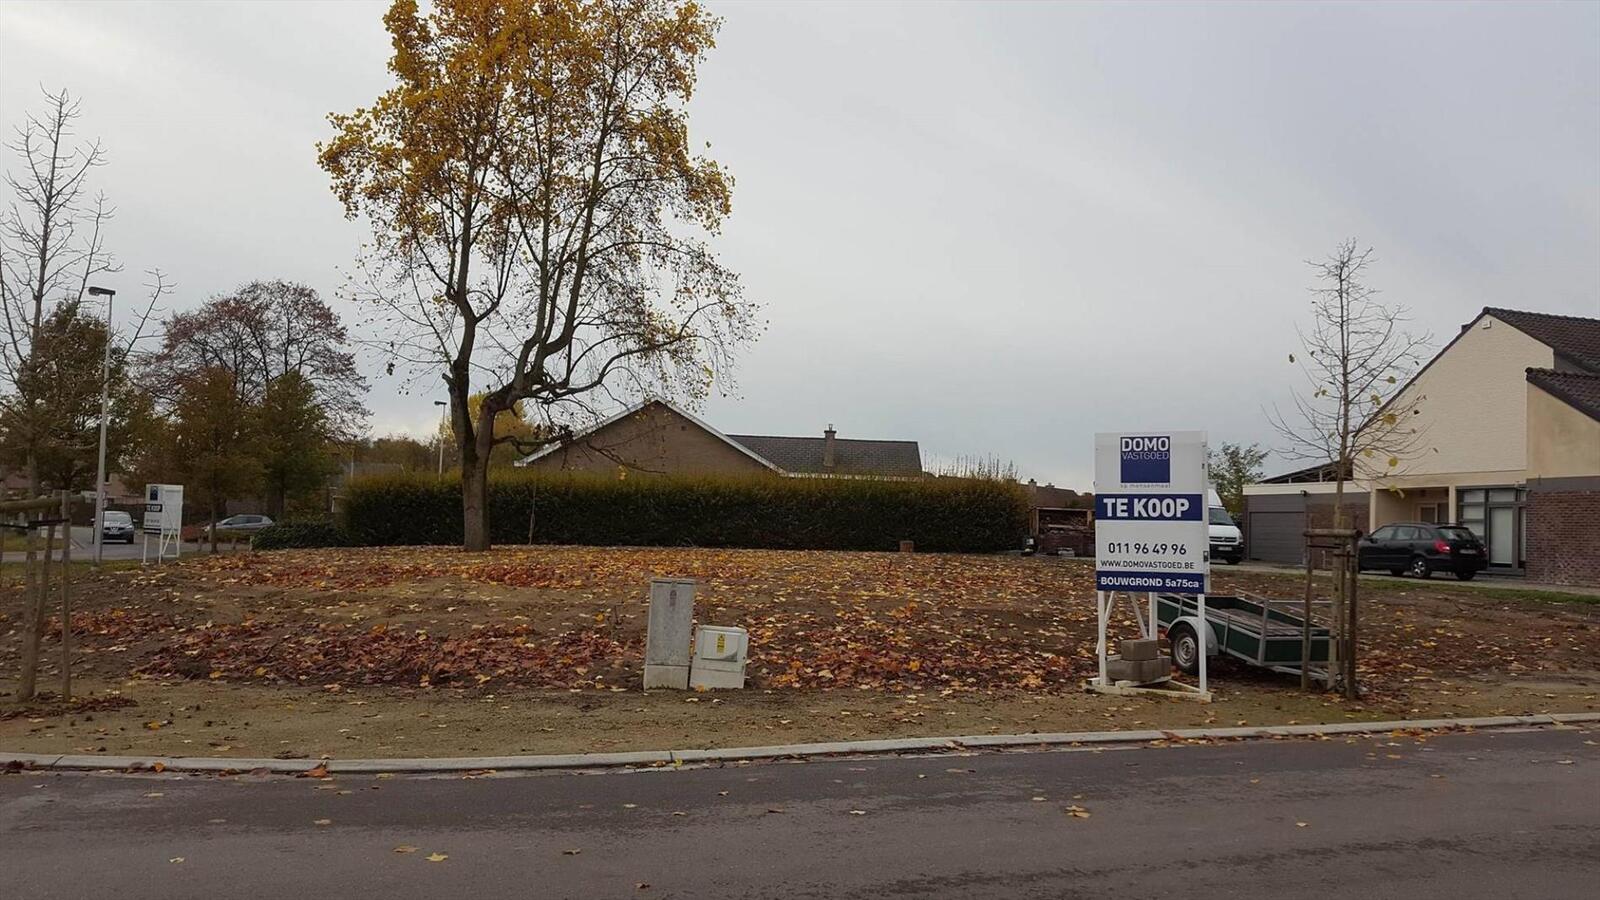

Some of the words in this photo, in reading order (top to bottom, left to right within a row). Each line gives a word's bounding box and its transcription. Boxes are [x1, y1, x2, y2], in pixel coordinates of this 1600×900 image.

[1122, 438, 1169, 452] DOMO
[1122, 452, 1169, 460] VASTGOED
[1103, 498, 1128, 517] TE
[1134, 498, 1190, 518] KOOP
[1108, 542, 1130, 554] 011
[1134, 543, 1149, 554] 96
[1152, 544, 1168, 554] 49
[1171, 544, 1186, 555] 96
[1100, 560, 1195, 570] WWW.DOMOVASTGOED.BE
[1101, 576, 1162, 586] BOUWGROND
[1166, 579, 1199, 588] 5a75ca
